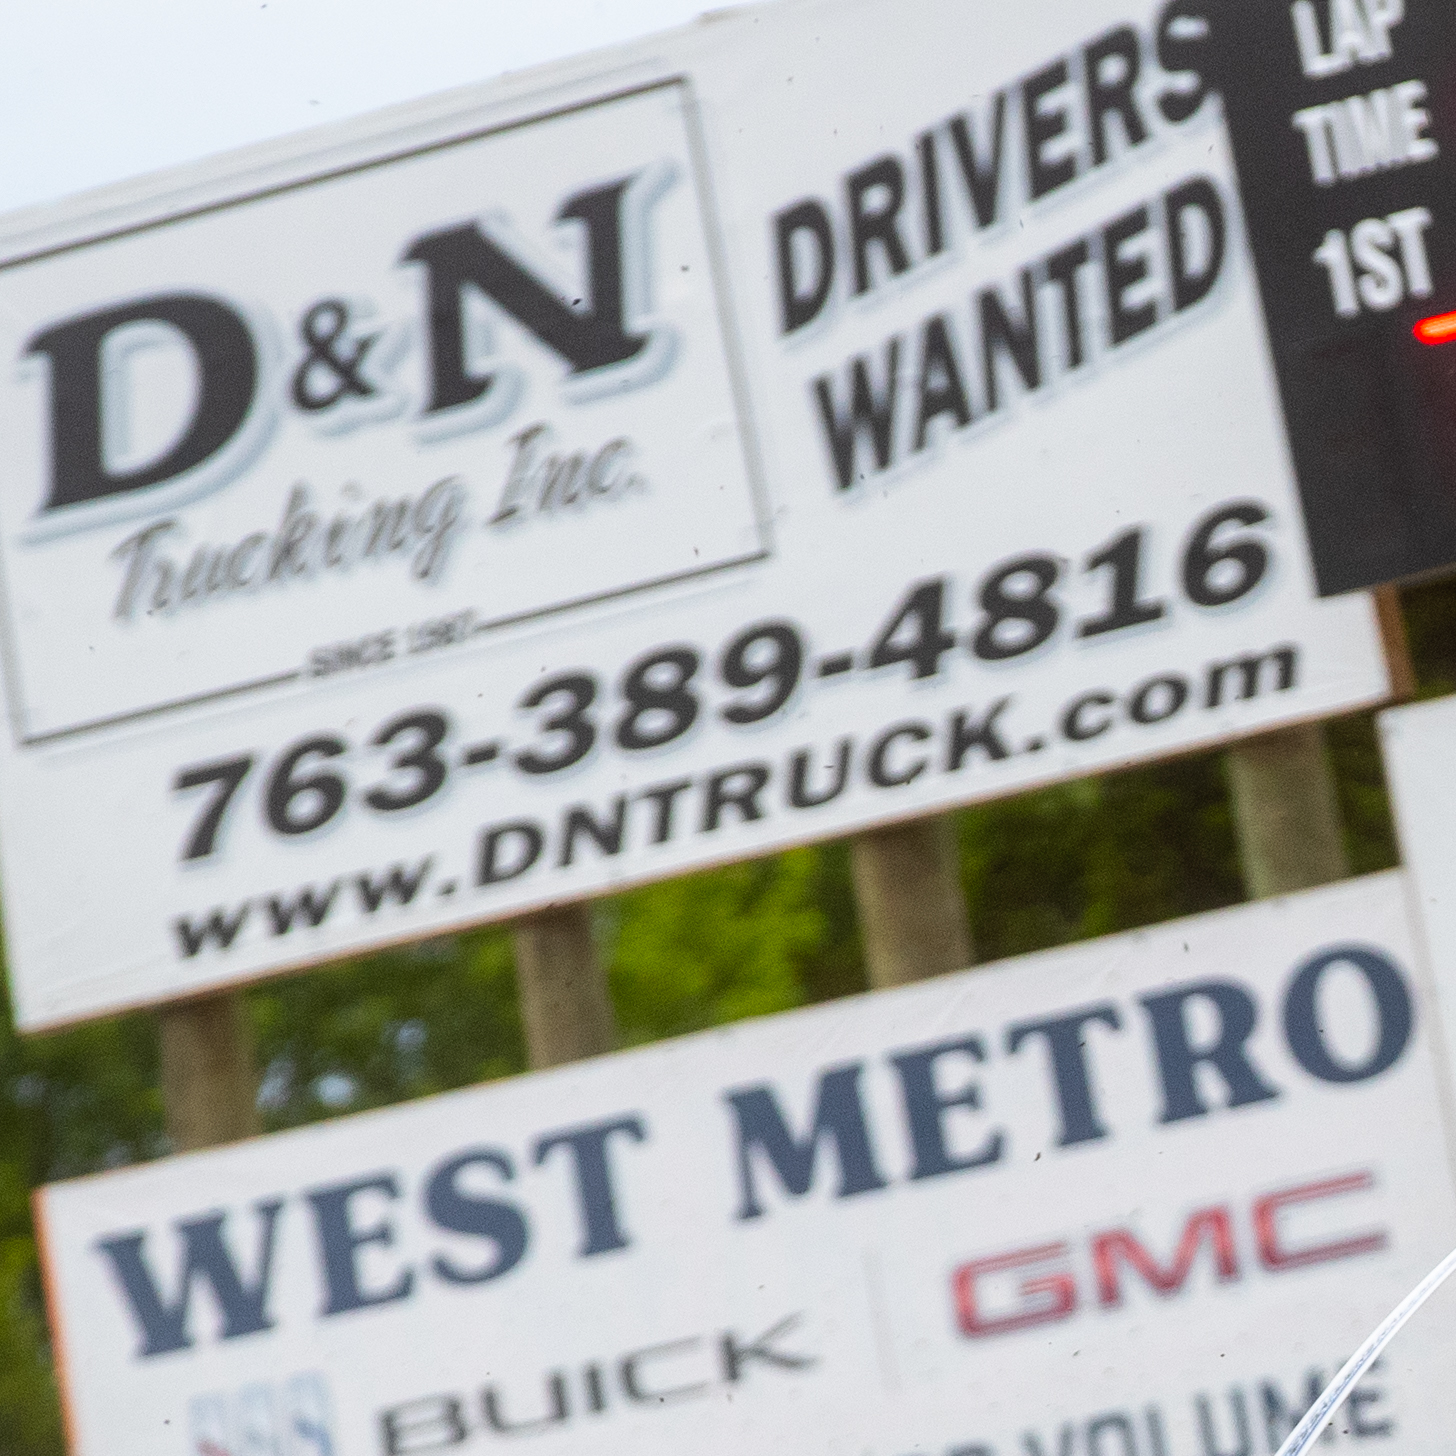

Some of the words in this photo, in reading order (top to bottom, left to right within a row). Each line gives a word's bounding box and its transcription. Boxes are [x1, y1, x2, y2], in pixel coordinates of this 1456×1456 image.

[1292, 0, 1402, 78] LAP
[1292, 80, 1439, 186] TIME
[769, 0, 1210, 338] DRIVERS
[1314, 206, 1434, 318] 1ST
[812, 175, 1224, 492] WANTED
[109, 475, 466, 620] Trucking
[486, 422, 646, 528] Inc.
[172, 496, 1276, 864] 763-389-4816
[172, 642, 1301, 960] www.DNTRUCK.com
[95, 1110, 643, 1358] WEST
[725, 941, 1414, 1224] METRO
[950, 1169, 1389, 1341] GMC
